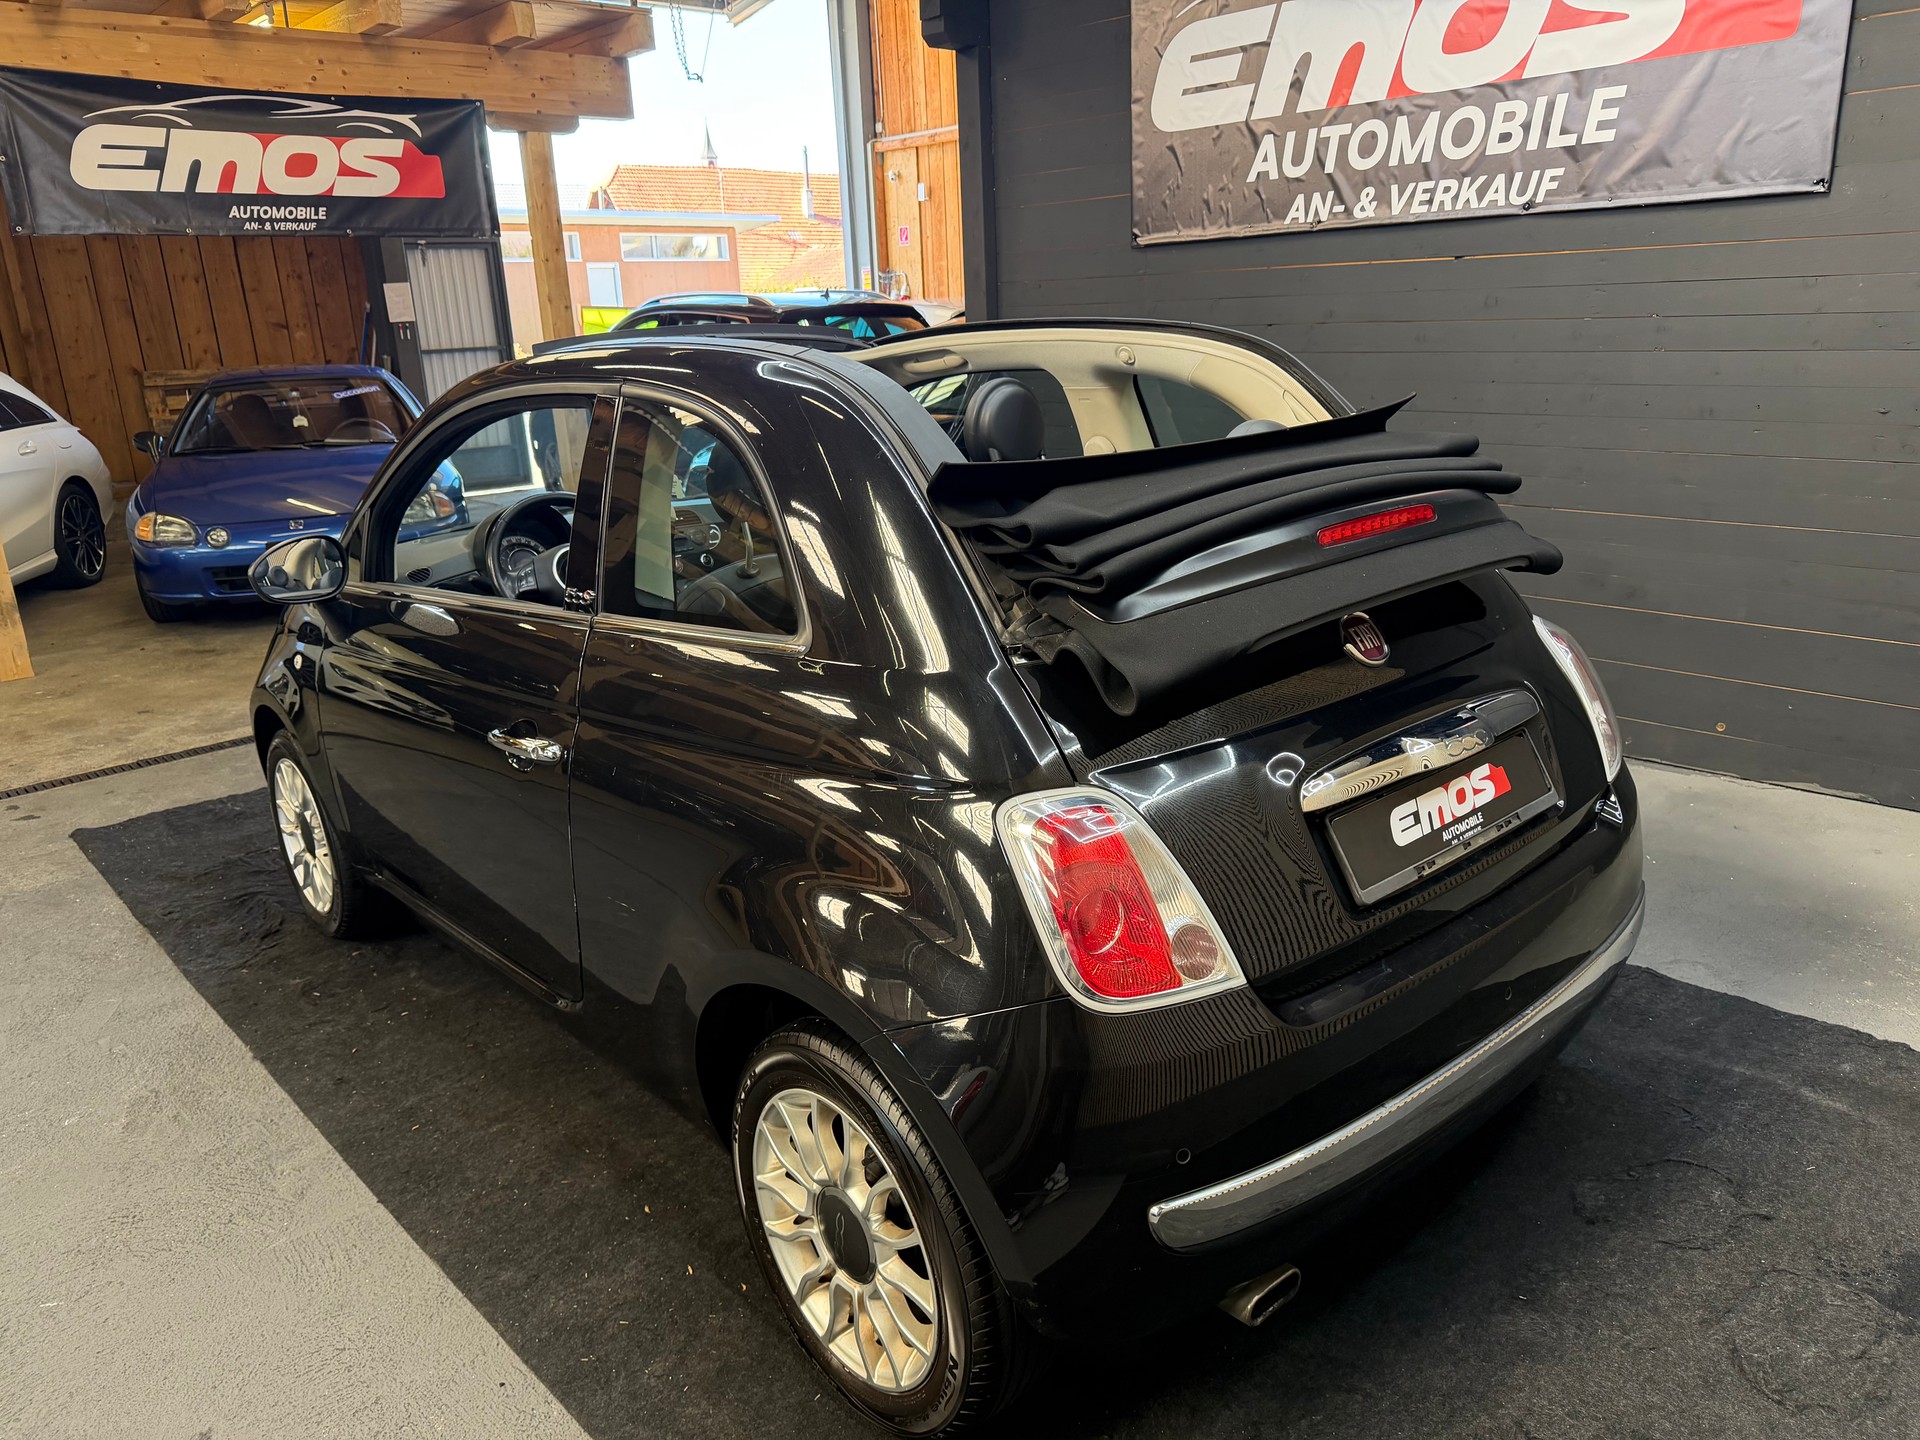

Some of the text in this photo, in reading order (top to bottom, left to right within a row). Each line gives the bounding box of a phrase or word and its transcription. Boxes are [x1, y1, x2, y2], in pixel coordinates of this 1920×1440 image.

[1247, 85, 1627, 182] AUTOMOBILE
[1284, 168, 1564, 224] AN- & VERKAUF
[229, 205, 327, 220] AUTOMOBILE
[243, 221, 317, 231] AN- & VERKAUF
[333, 385, 381, 399] Occasion
[1348, 622, 1381, 651] FIAT
[1442, 811, 1484, 842] AUTOMOBILE
